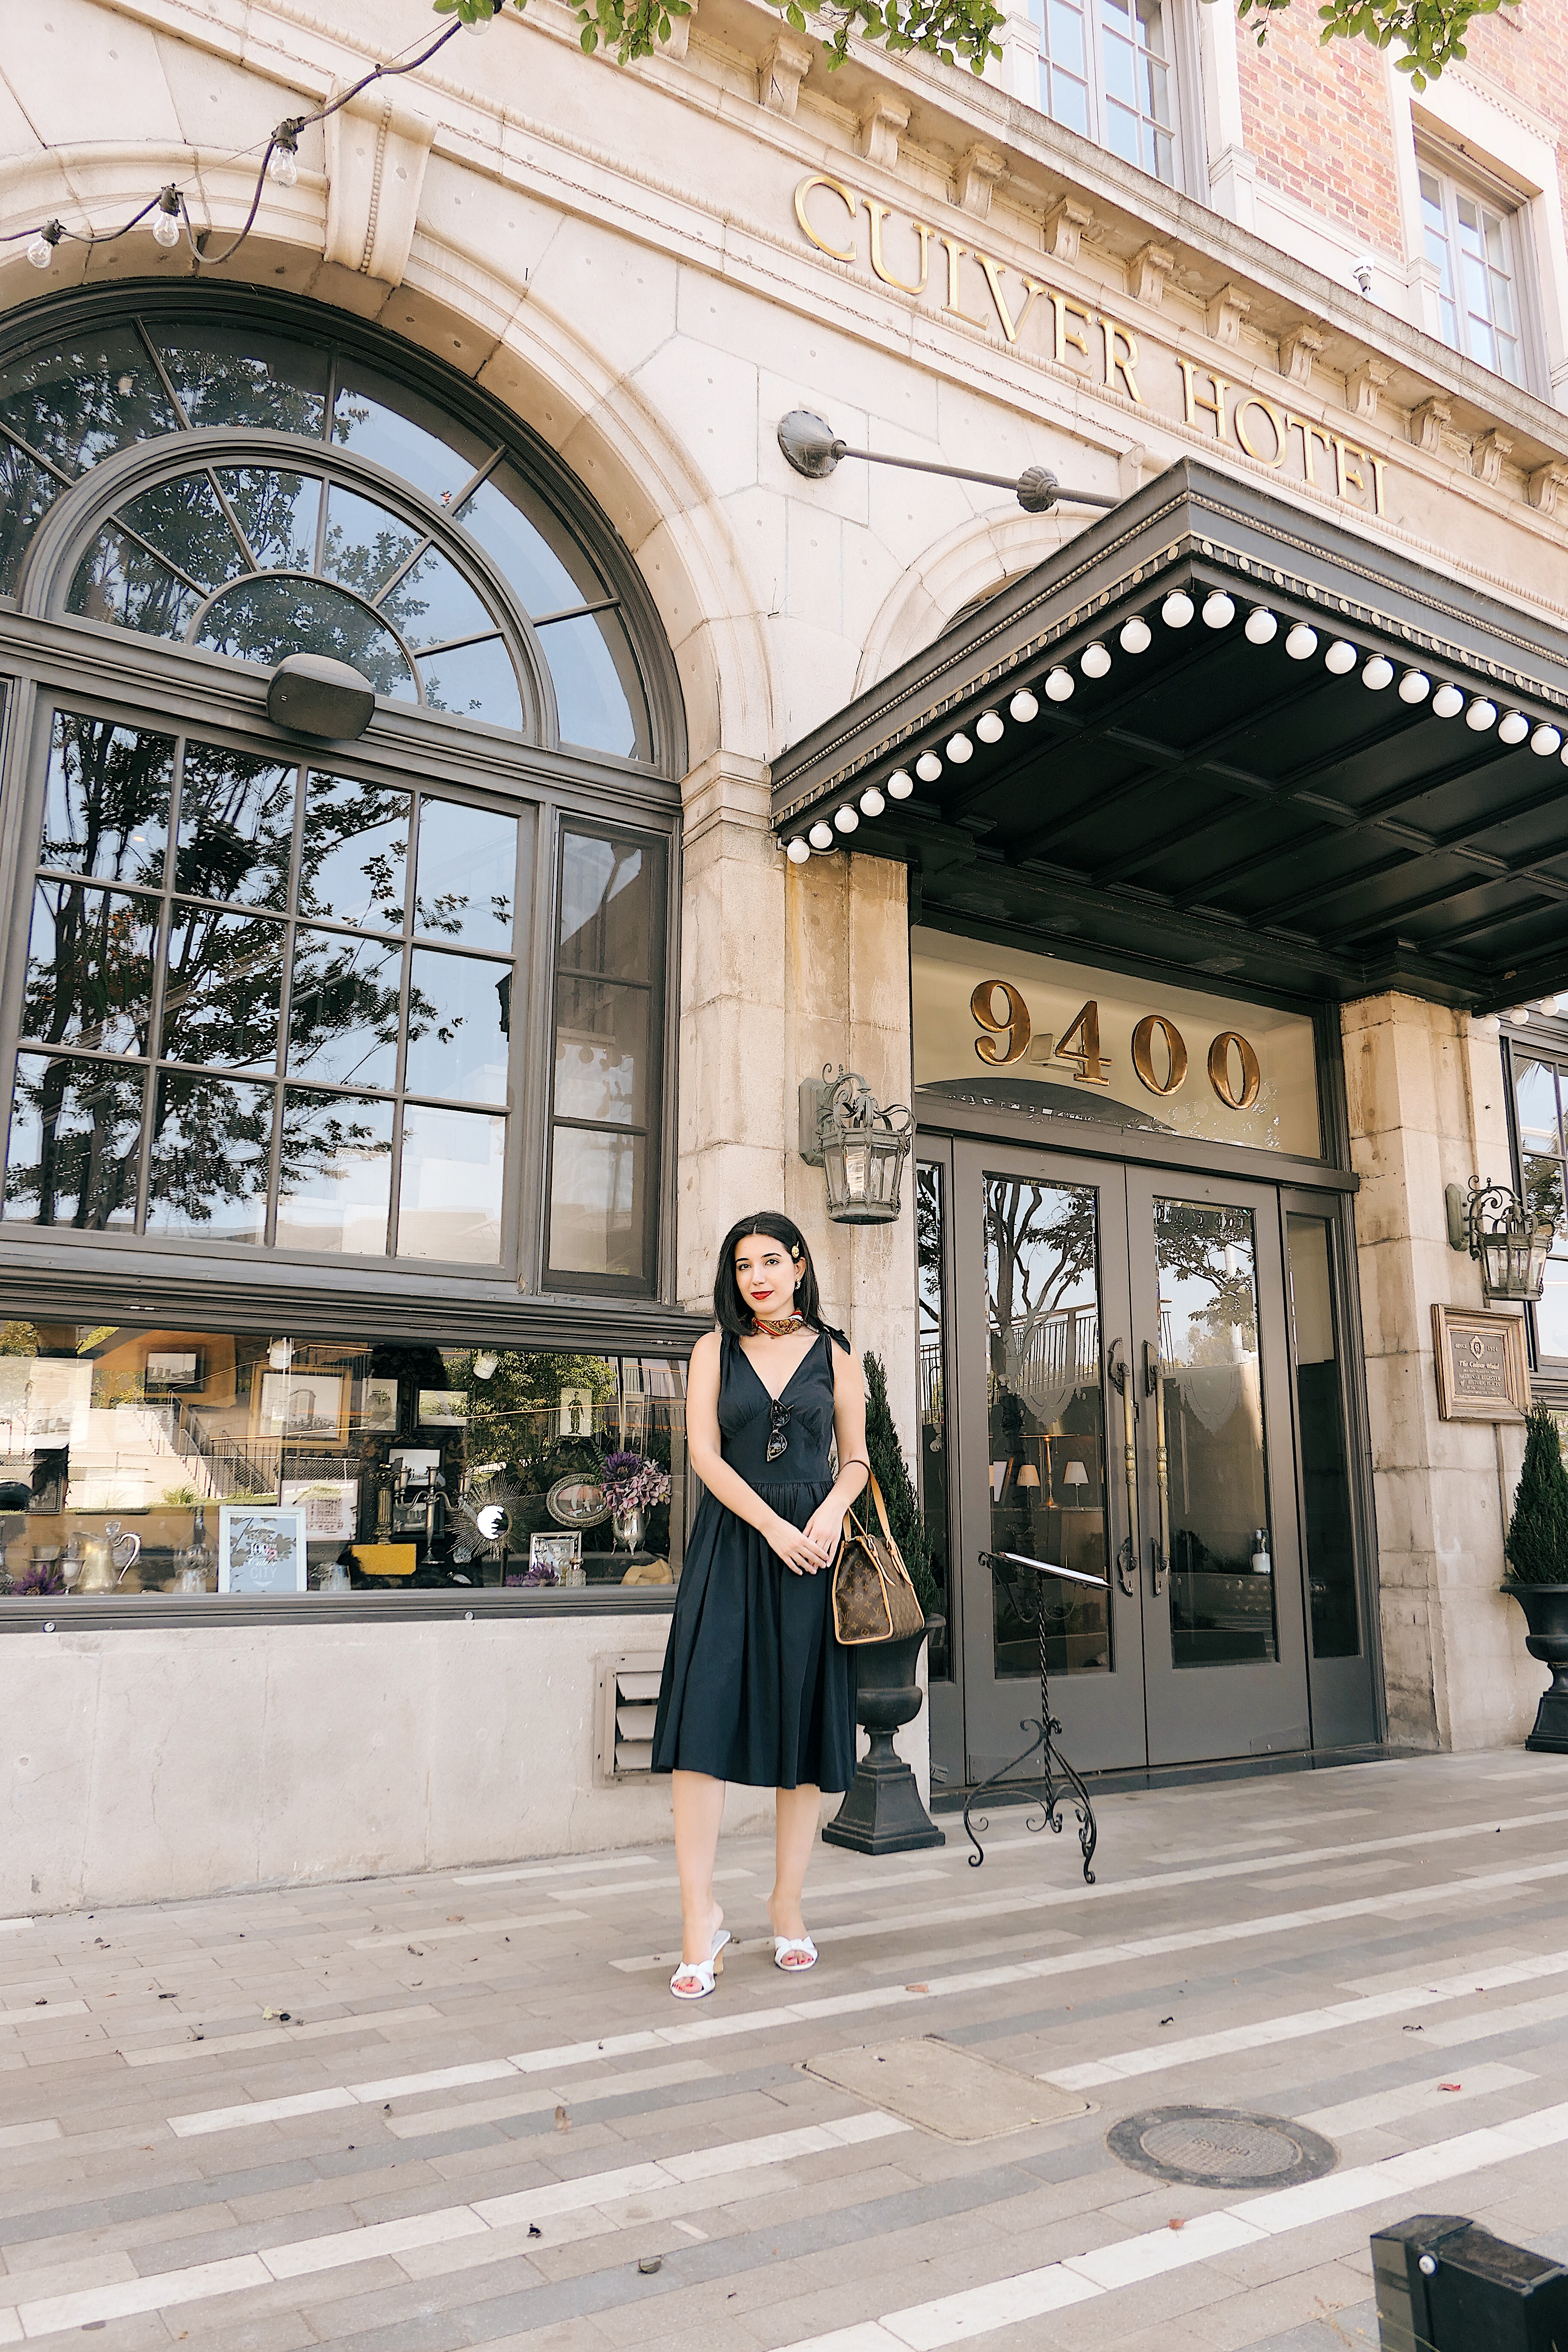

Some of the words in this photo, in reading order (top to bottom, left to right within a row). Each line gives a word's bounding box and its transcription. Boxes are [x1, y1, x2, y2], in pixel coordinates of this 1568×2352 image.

[794, 175, 1151, 409] CULVER
[1176, 357, 1406, 528] HOTEL
[971, 979, 1260, 1110] 9400
